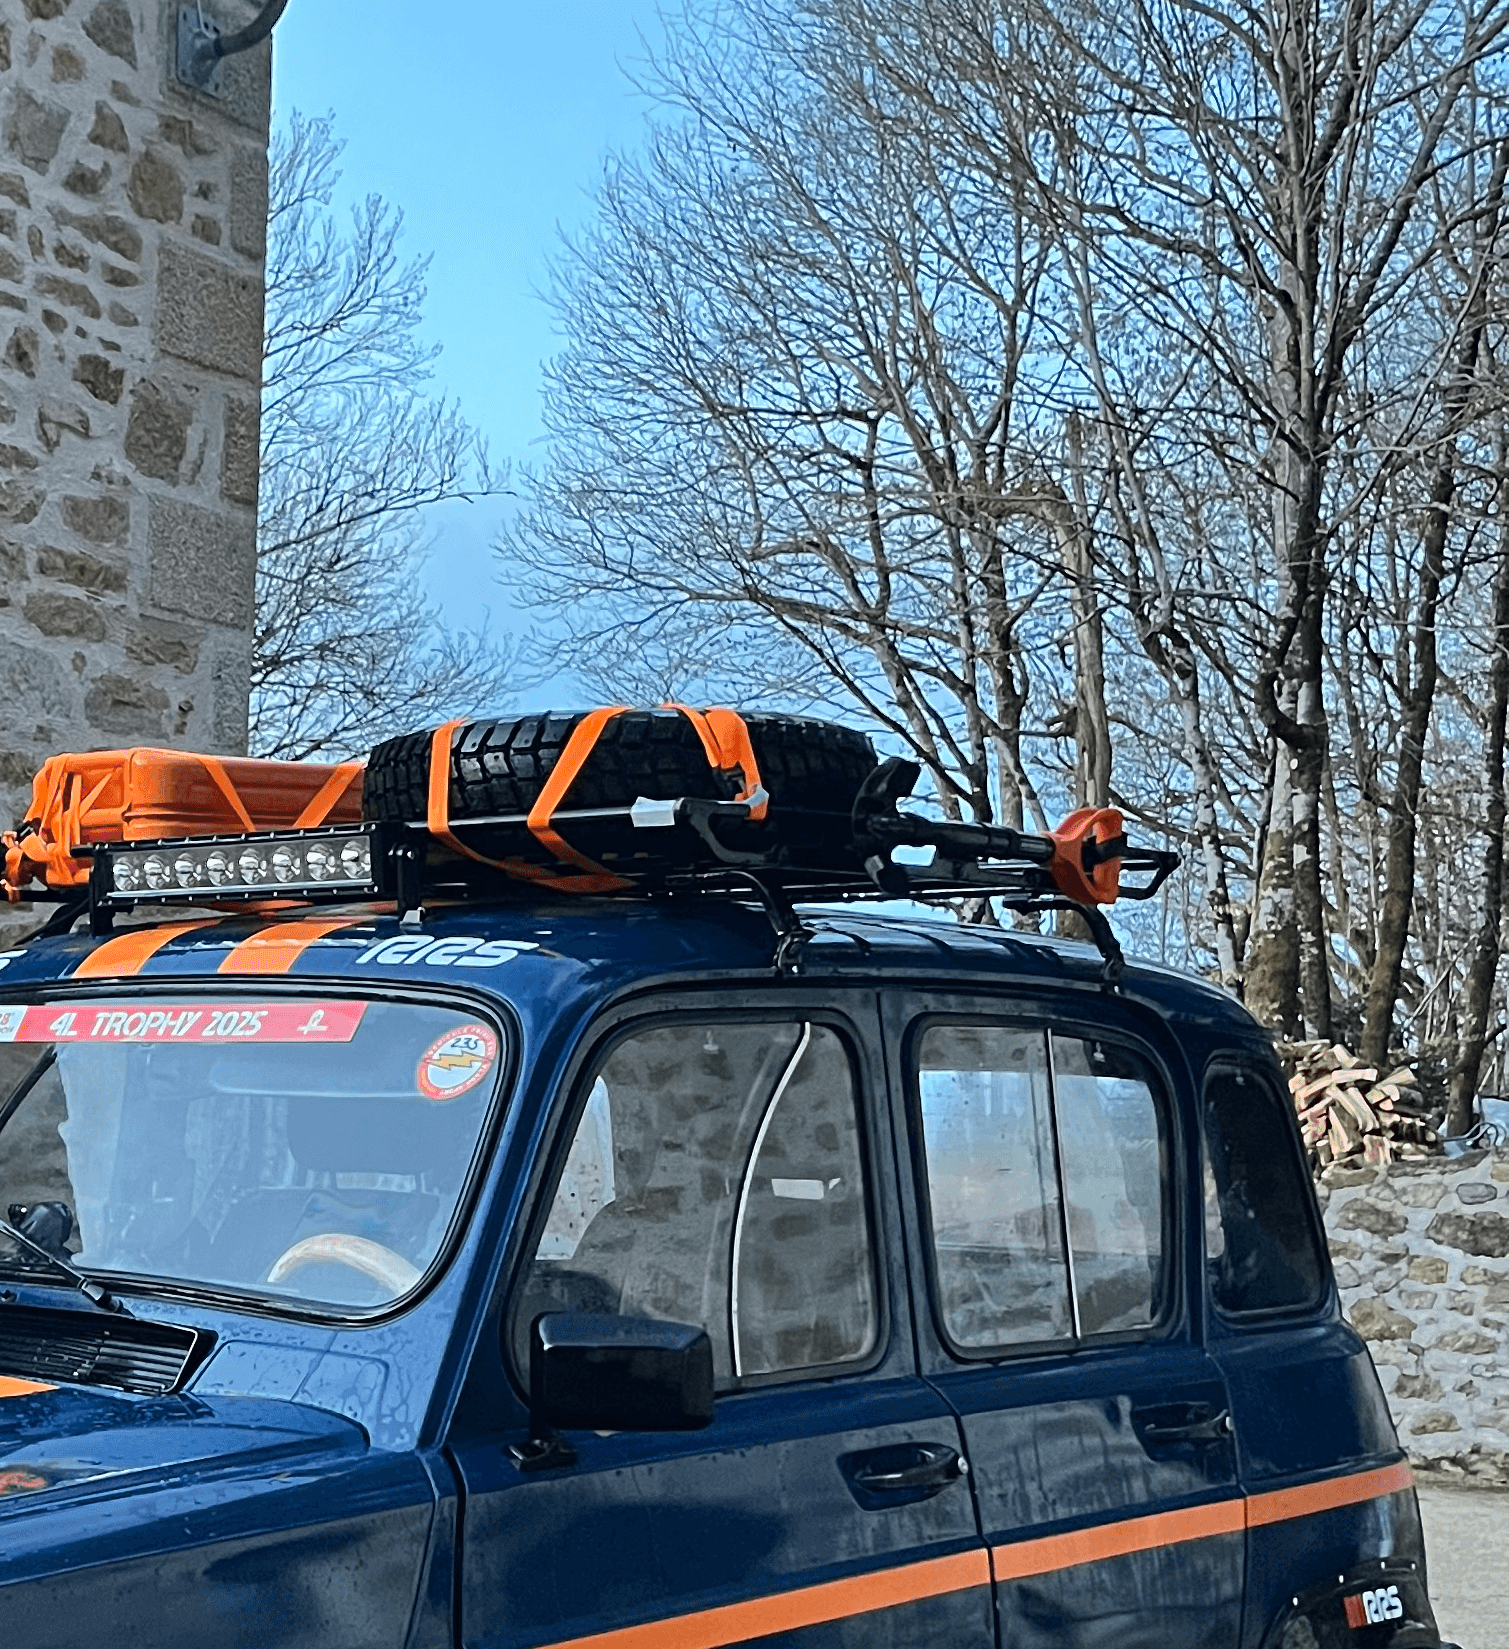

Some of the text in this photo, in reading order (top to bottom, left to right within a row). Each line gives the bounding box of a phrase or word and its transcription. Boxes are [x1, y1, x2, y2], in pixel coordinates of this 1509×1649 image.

[356, 935, 540, 968] RRS
[49, 1010, 269, 1037] 4L TROPHY 2025
[1362, 1585, 1403, 1625] RRS
